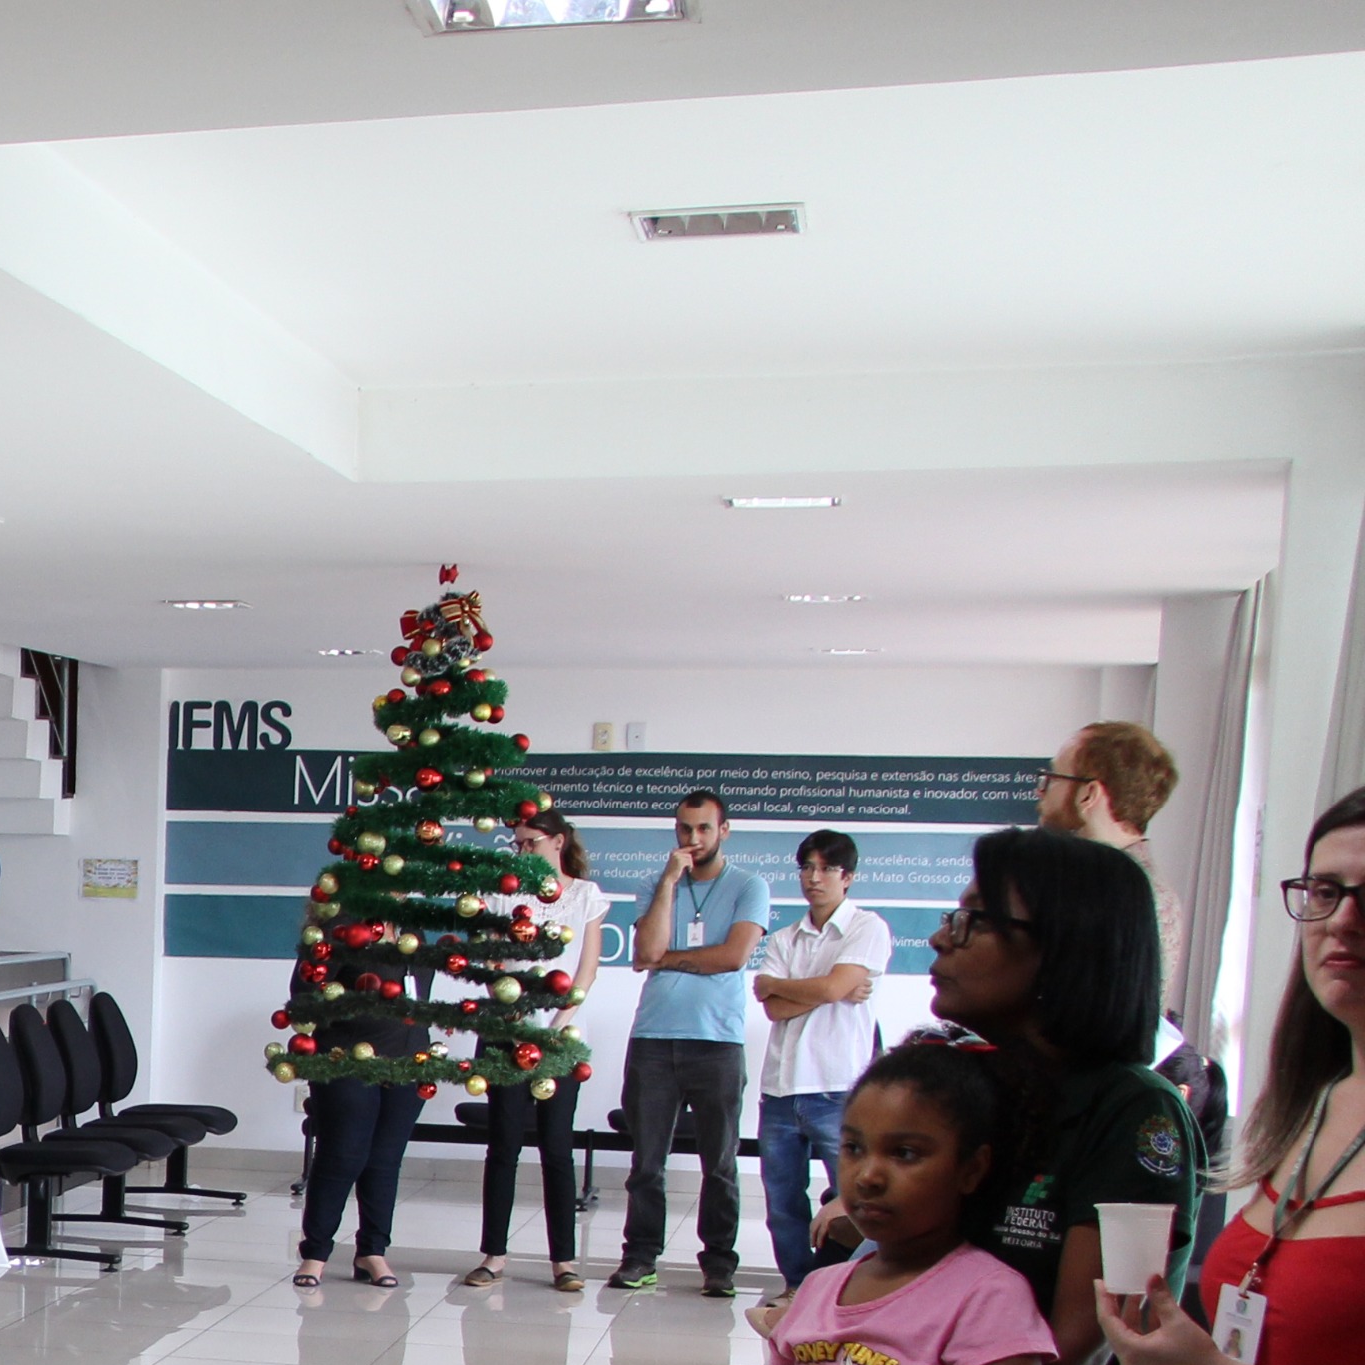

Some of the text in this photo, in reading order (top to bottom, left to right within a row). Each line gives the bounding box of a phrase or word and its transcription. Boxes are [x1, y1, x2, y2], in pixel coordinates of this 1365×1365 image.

[169, 700, 292, 750] IFMS
[550, 768, 557, 777] a
[560, 765, 615, 779] educação
[617, 765, 632, 777] de
[635, 765, 694, 779] excelência
[697, 769, 717, 782] por
[720, 768, 749, 779] meio
[752, 768, 768, 780] do
[771, 768, 812, 782] ensino,
[816, 770, 867, 783] pesquisa
[870, 772, 879, 781] e
[881, 770, 935, 782] extensão
[938, 773, 959, 783] nas
[961, 771, 1011, 784] diversas
[1013, 771, 1038, 783] área
[592, 781, 633, 794] técnico
[636, 784, 644, 794] e
[719, 784, 777, 796] formando
[779, 785, 846, 798] profissional
[848, 786, 910, 799] humanista
[913, 789, 921, 799] e
[924, 788, 979, 801] inovador,
[982, 790, 1009, 800] com
[1012, 789, 1040, 801] vista
[553, 798, 649, 810] desenvolvimento
[728, 802, 761, 812] social
[764, 801, 794, 814] local,
[797, 803, 845, 816] regional
[847, 804, 856, 814] e
[858, 804, 911, 816] nacional.
[604, 851, 670, 862] reconhecid
[864, 854, 932, 868] excelência,
[935, 855, 974, 867] sendo
[853, 872, 869, 882] de
[872, 872, 905, 883] Mato
[907, 872, 951, 884] Grosso
[953, 873, 971, 884] do
[1006, 1206, 1055, 1222] INSTITUTO
[1004, 1216, 1050, 1231] FEDERAL
[1002, 1236, 1043, 1248] REITORIA
